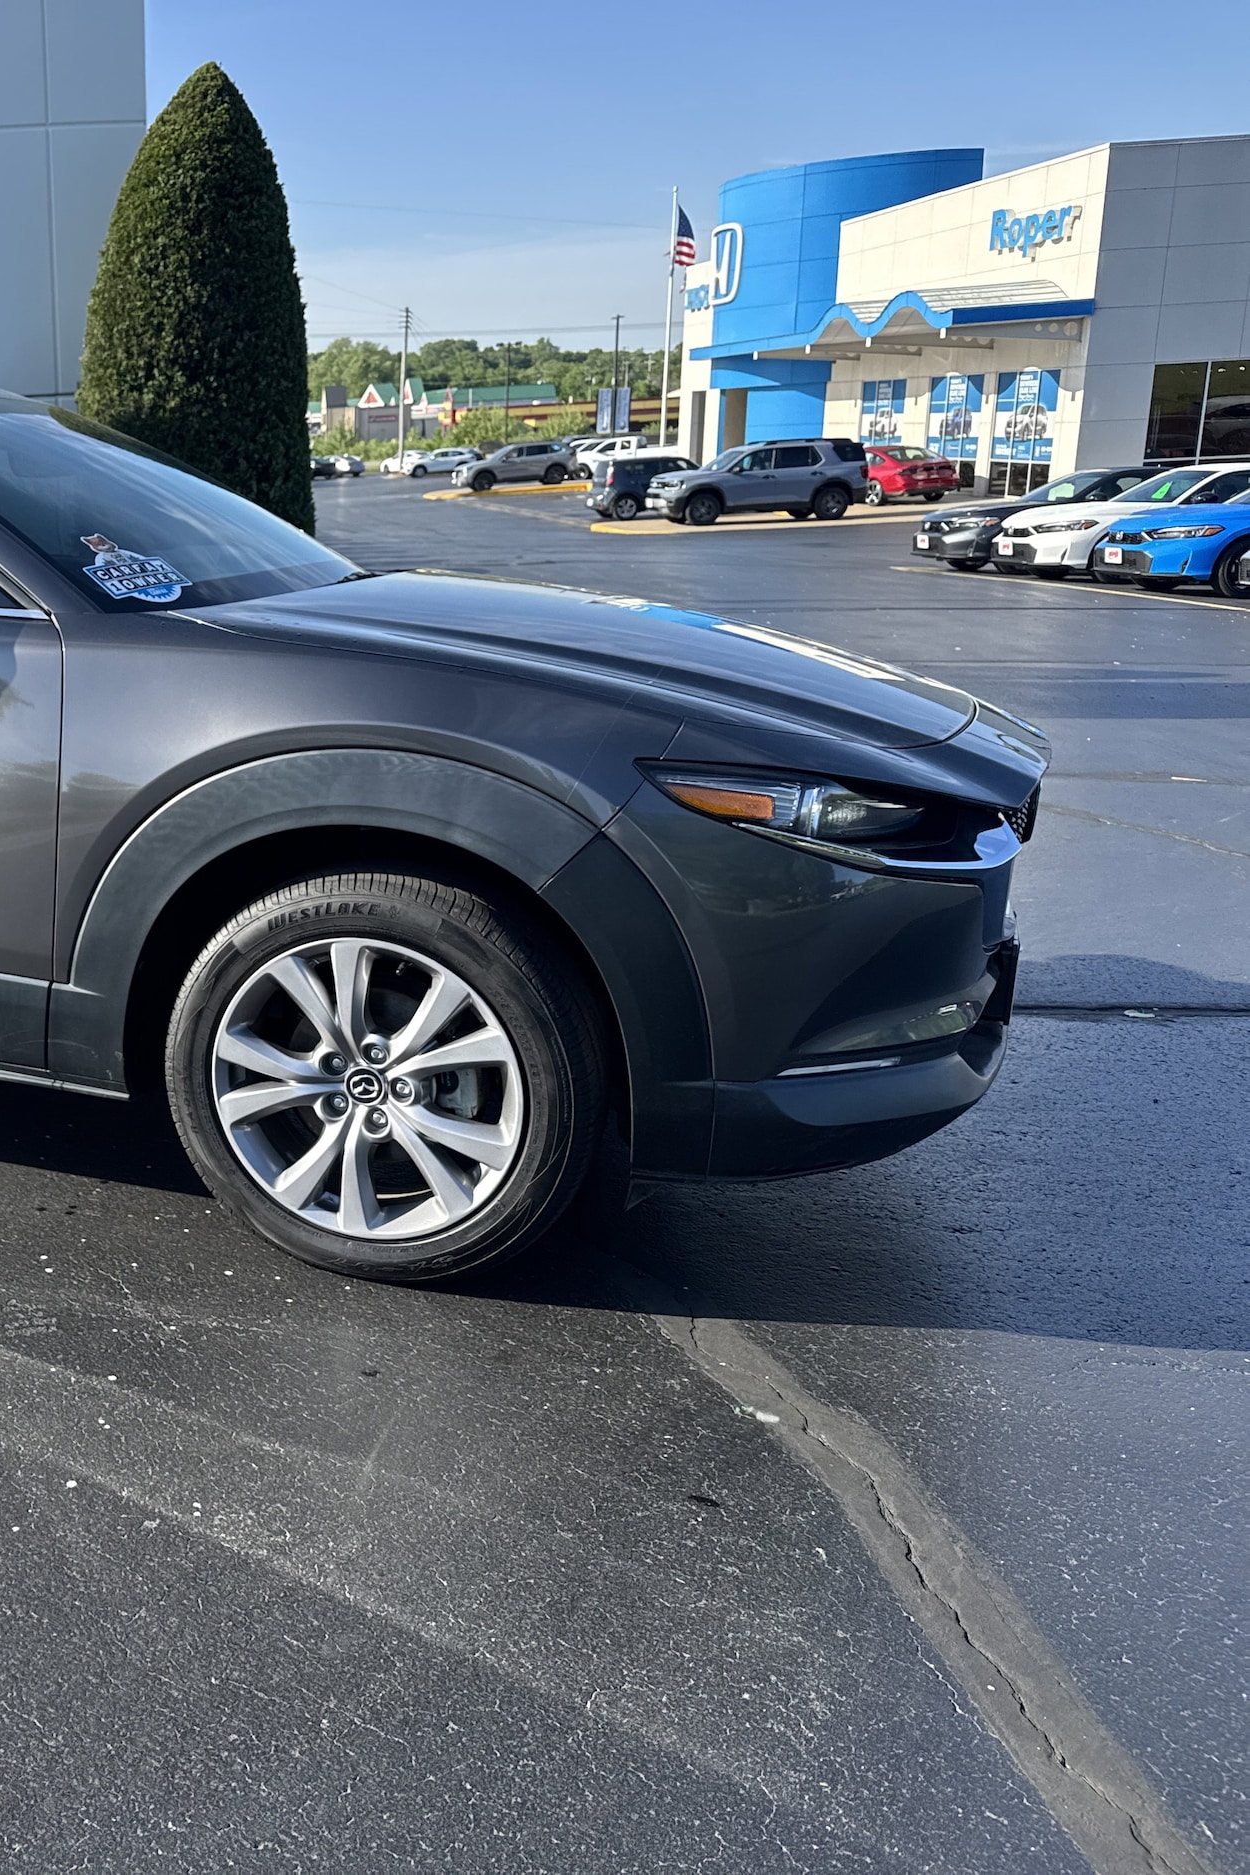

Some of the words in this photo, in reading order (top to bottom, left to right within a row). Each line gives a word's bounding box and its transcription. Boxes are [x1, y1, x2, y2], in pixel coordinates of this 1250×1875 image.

[989, 205, 1074, 258] Roper
[96, 561, 170, 580] CARFAX
[109, 582, 123, 592] 1
[122, 573, 181, 590] OWNER
[267, 902, 381, 931] WESTLAKE
